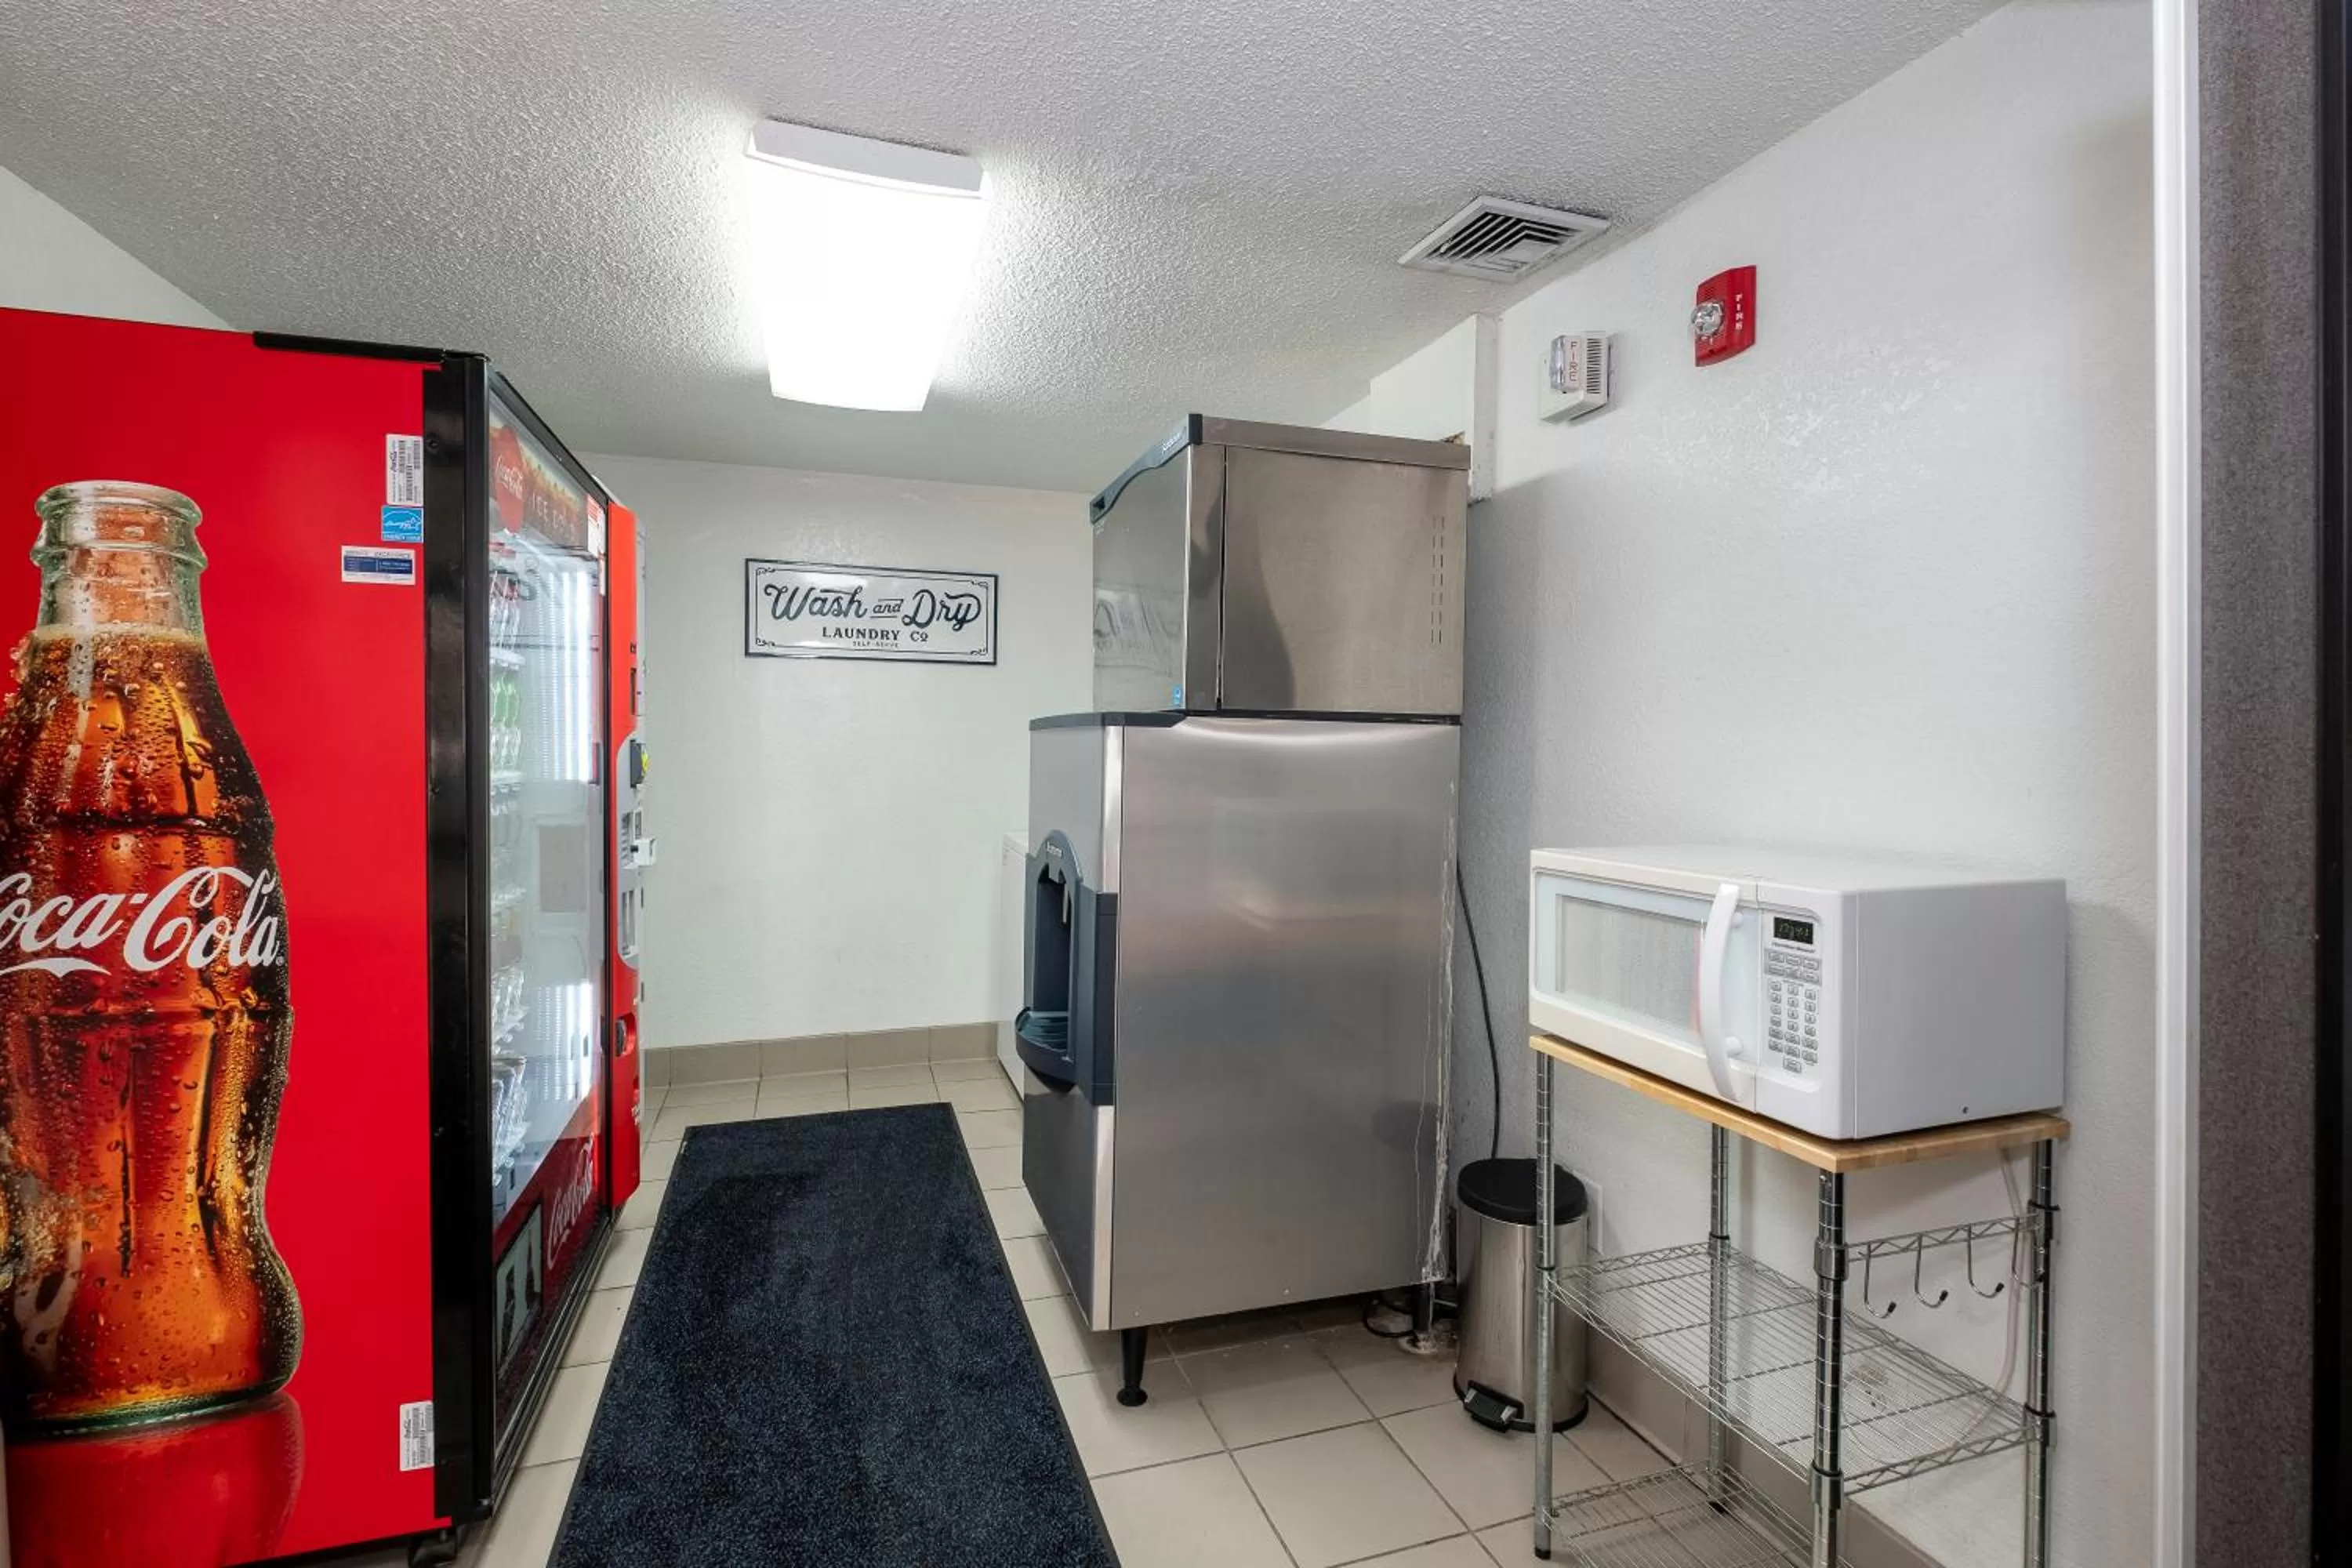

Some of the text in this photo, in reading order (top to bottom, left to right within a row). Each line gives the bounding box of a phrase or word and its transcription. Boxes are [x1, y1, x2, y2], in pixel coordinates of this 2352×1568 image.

[1734, 293, 1743, 330] FIRE
[1569, 341, 1578, 383] FIRE
[764, 583, 982, 632] Wash and Dry
[822, 626, 901, 641] LAUNDRY
